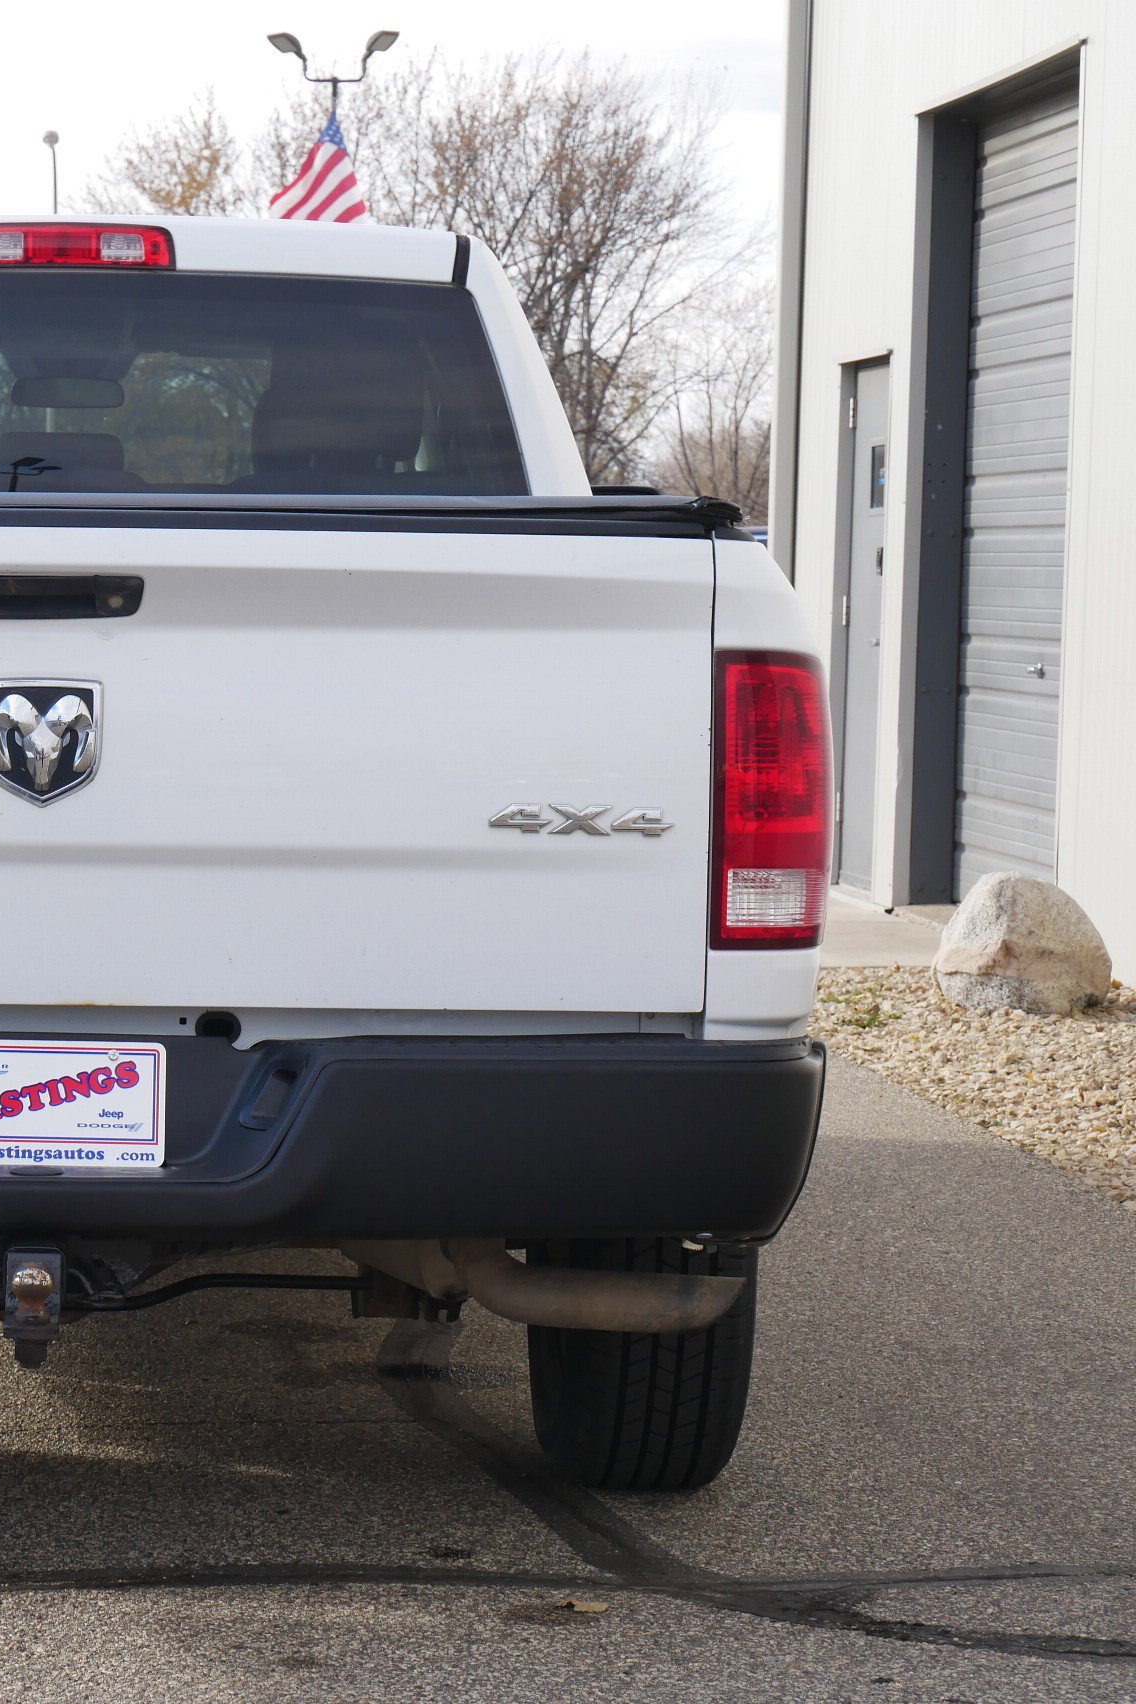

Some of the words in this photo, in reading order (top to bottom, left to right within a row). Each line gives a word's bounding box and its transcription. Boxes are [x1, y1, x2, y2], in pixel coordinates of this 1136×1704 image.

[488, 802, 675, 836] 4X4
[98, 1108, 124, 1120] Jeep
[116, 1150, 156, 1161] .com
